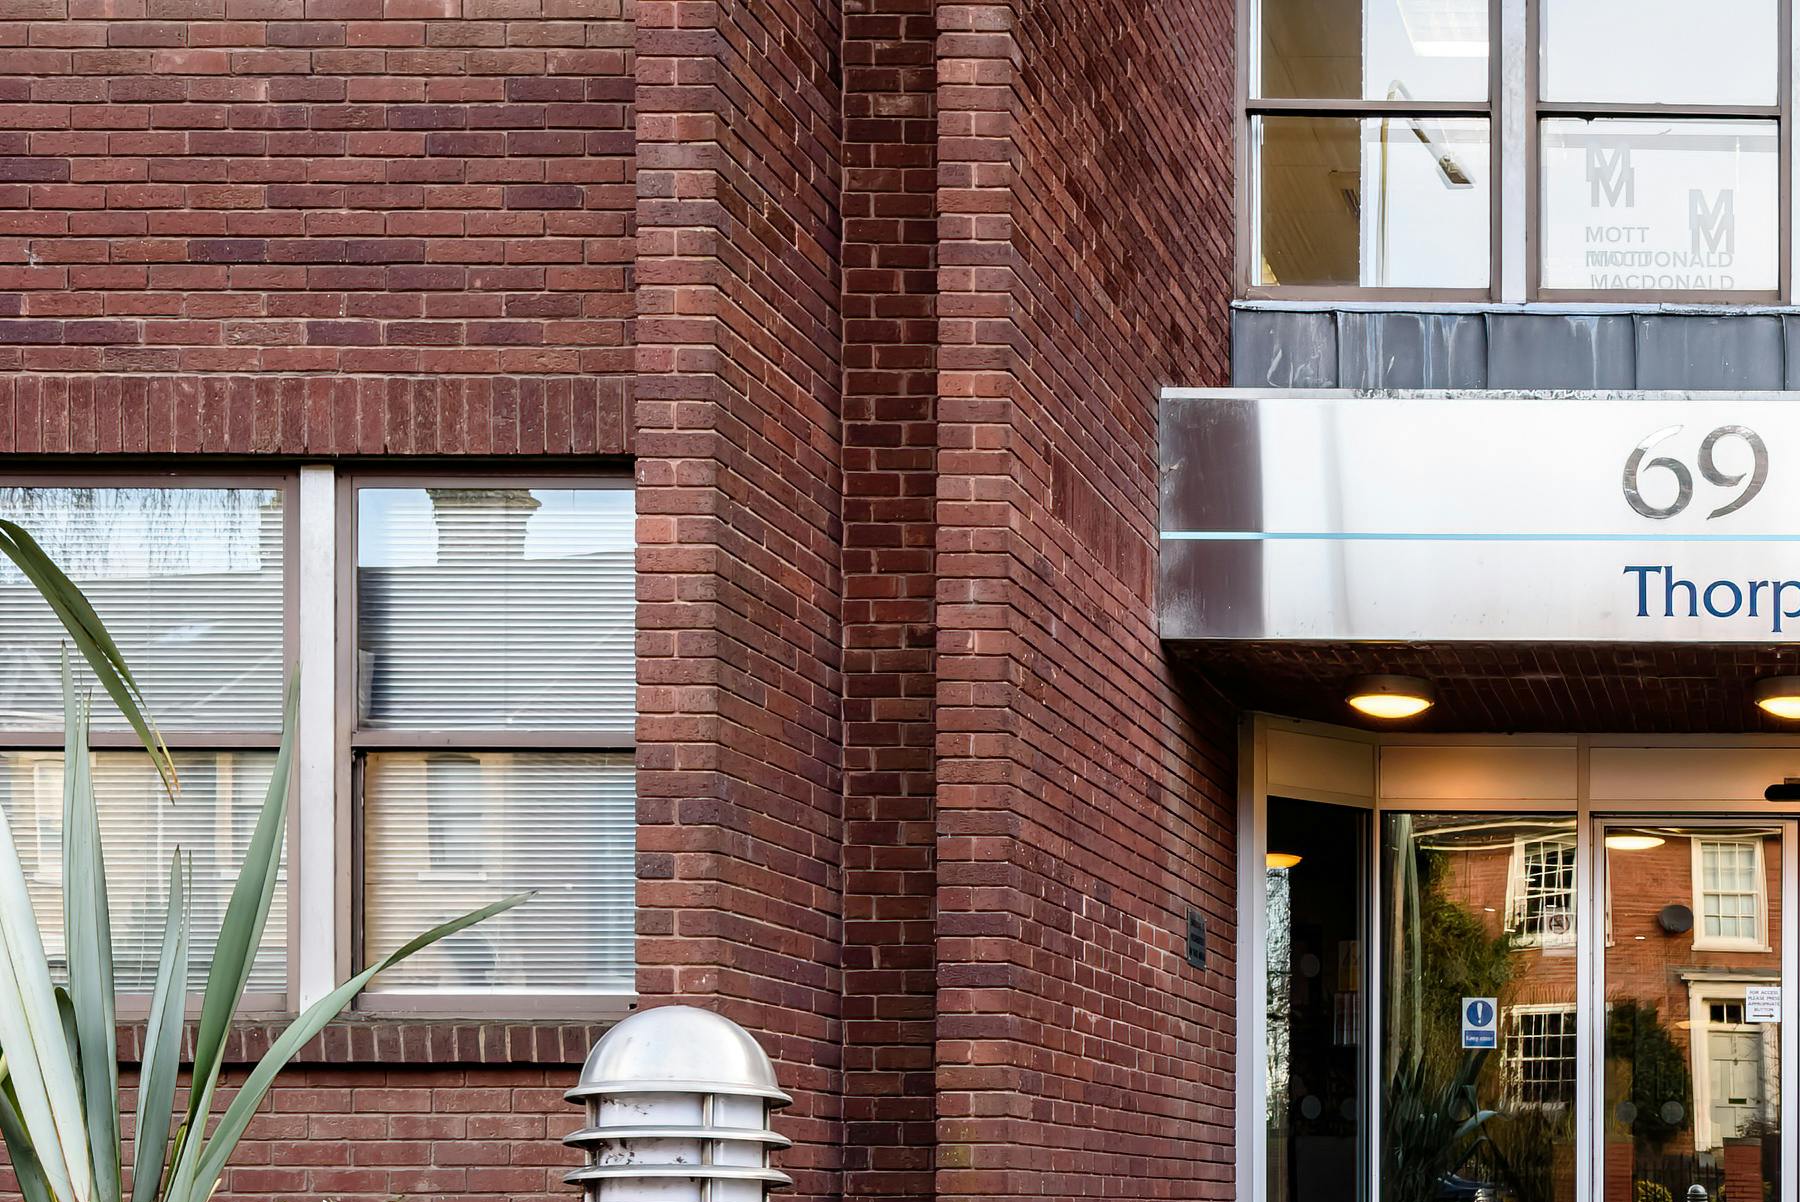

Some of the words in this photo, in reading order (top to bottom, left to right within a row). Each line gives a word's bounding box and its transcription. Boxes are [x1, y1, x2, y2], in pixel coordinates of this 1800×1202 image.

[1585, 226, 1650, 243] MOTT
[1591, 274, 1735, 289] MACDONALD
[1622, 424, 1769, 520] 69
